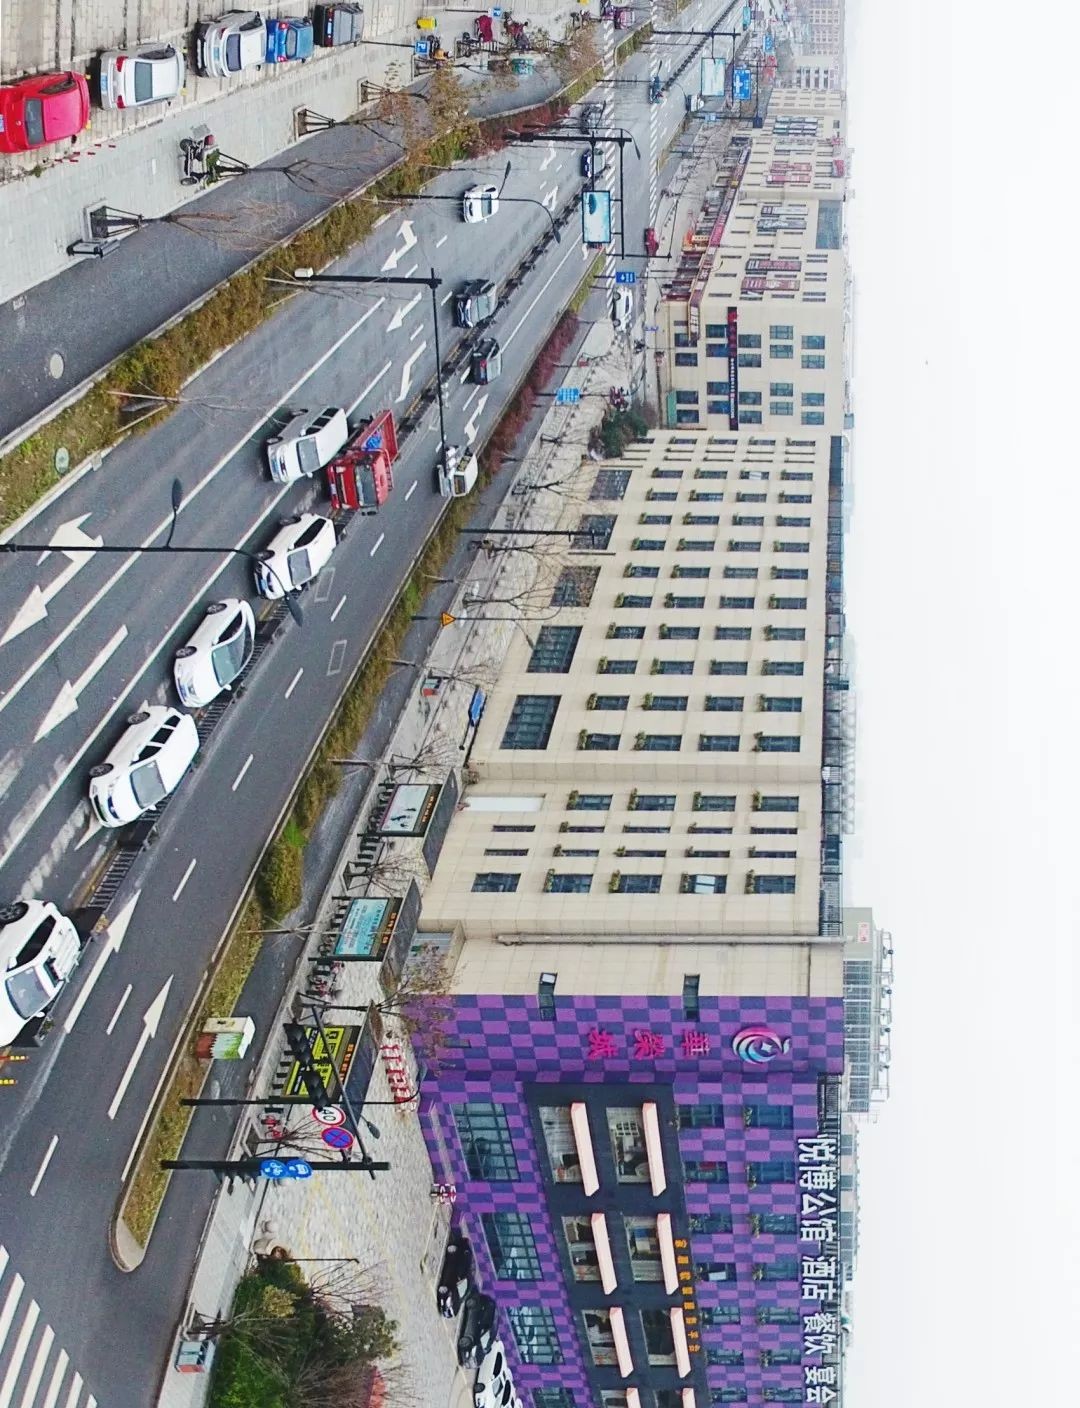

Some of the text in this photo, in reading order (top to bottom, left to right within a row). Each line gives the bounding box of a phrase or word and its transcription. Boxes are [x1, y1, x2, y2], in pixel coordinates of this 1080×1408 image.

[798, 1134, 836, 1242] 悦博公馆
[801, 1256, 836, 1300] 酒店
[803, 1312, 836, 1355] 餐饮
[804, 1366, 836, 1403] 宴会
